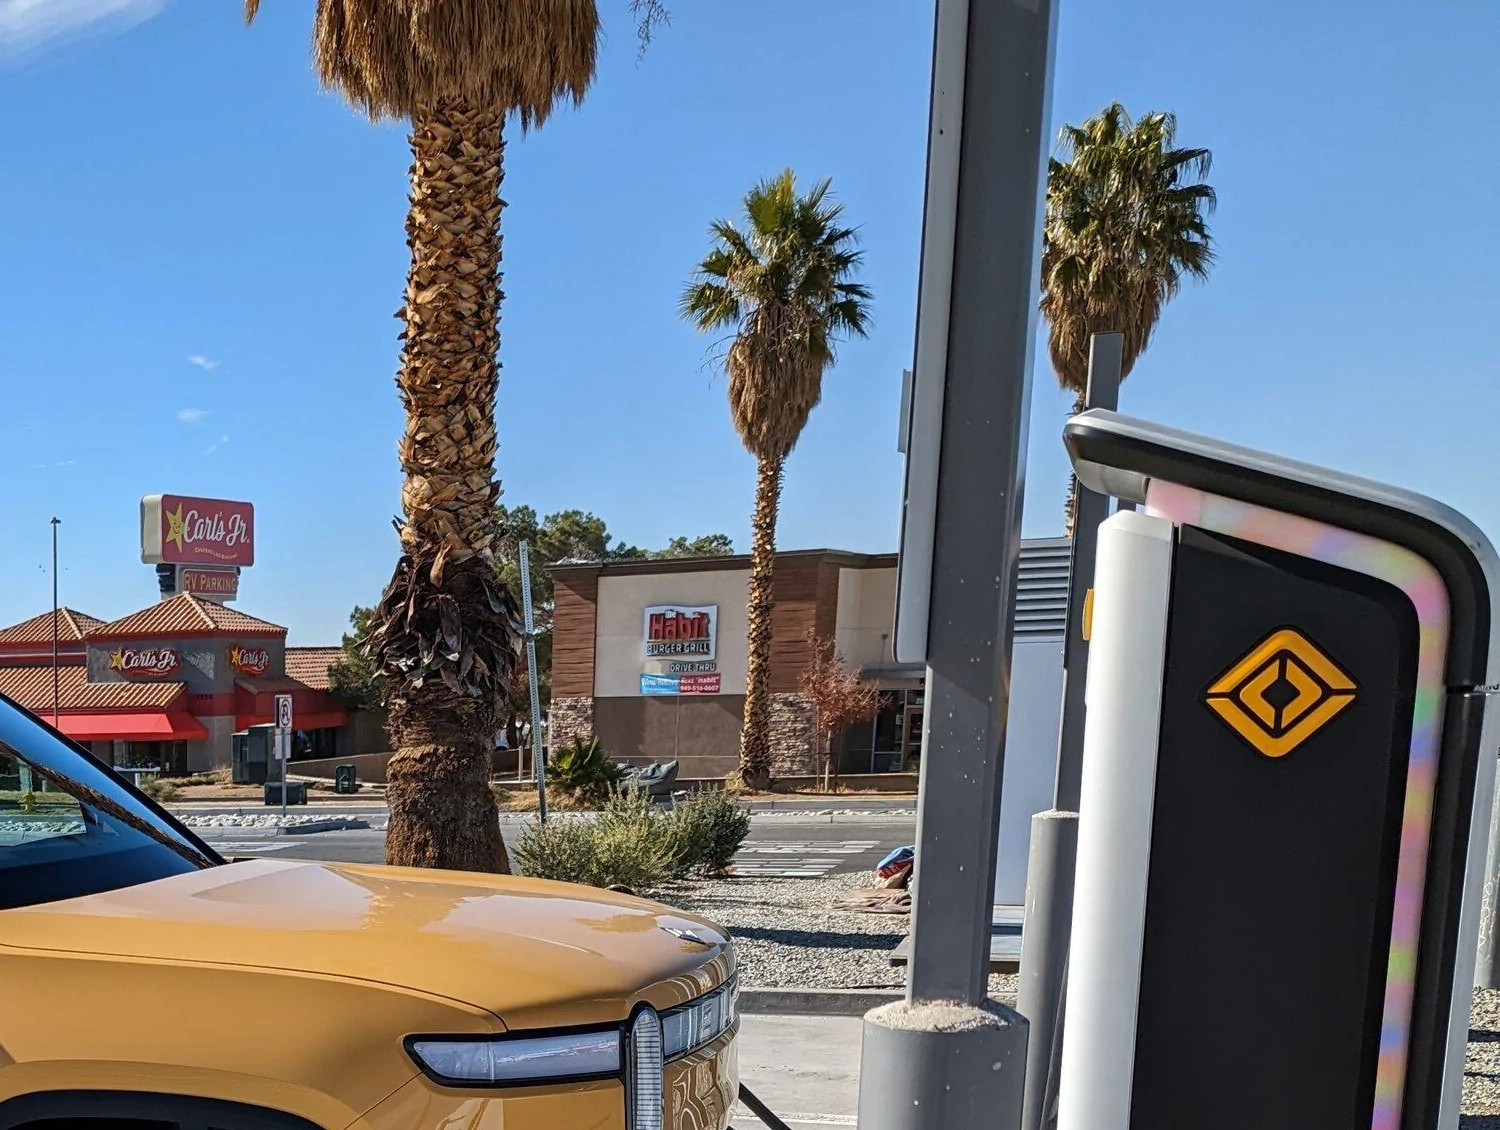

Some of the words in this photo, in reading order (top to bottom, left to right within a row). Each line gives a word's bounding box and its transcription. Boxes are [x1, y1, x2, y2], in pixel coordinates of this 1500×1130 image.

[184, 510, 226, 543] Carl's
[226, 514, 250, 547] Jr.
[184, 573, 198, 590] RV
[200, 574, 237, 591] PARKING
[650, 612, 710, 640] Habit
[647, 644, 682, 654] BURGER
[683, 642, 709, 653] GRILL
[122, 650, 156, 670] Carl's
[670, 663, 694, 673] DRIVE
[695, 662, 717, 672] THRU
